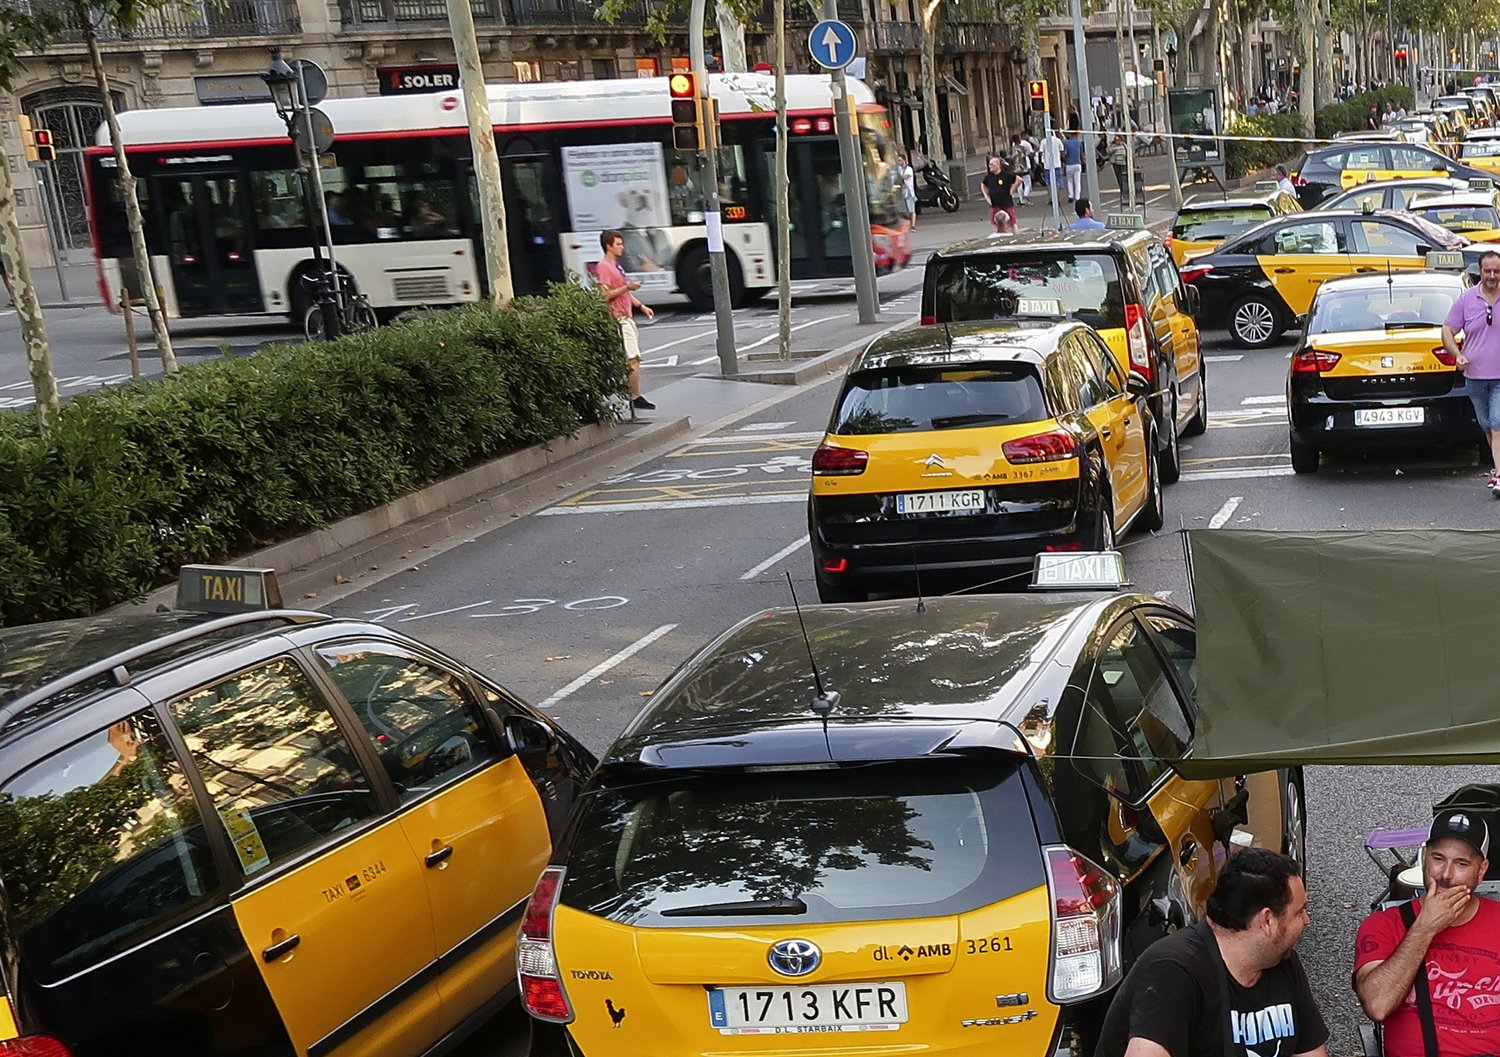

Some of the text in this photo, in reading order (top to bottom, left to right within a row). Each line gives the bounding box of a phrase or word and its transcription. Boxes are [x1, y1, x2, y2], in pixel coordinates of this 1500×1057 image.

[403, 74, 454, 88] SOLER
[1118, 217, 1134, 226] TAXI
[1438, 254, 1455, 264] TAXI
[1031, 301, 1049, 313] TAXI
[1361, 376, 1416, 384] TOLEDO
[1363, 410, 1420, 422] 4943 KGV
[1013, 470, 1034, 479] 3367
[908, 492, 981, 510] 1711 KGR
[1063, 554, 1101, 580] TAXI
[202, 575, 242, 601] TAXI
[322, 883, 345, 903] TAXI
[362, 860, 387, 883] 6344
[917, 943, 951, 958] AMB
[966, 936, 1014, 955] 3261
[570, 970, 613, 981] TOYOTA
[715, 988, 898, 1022] E 1713 KFR
[797, 1024, 843, 1033] STARBAIX
